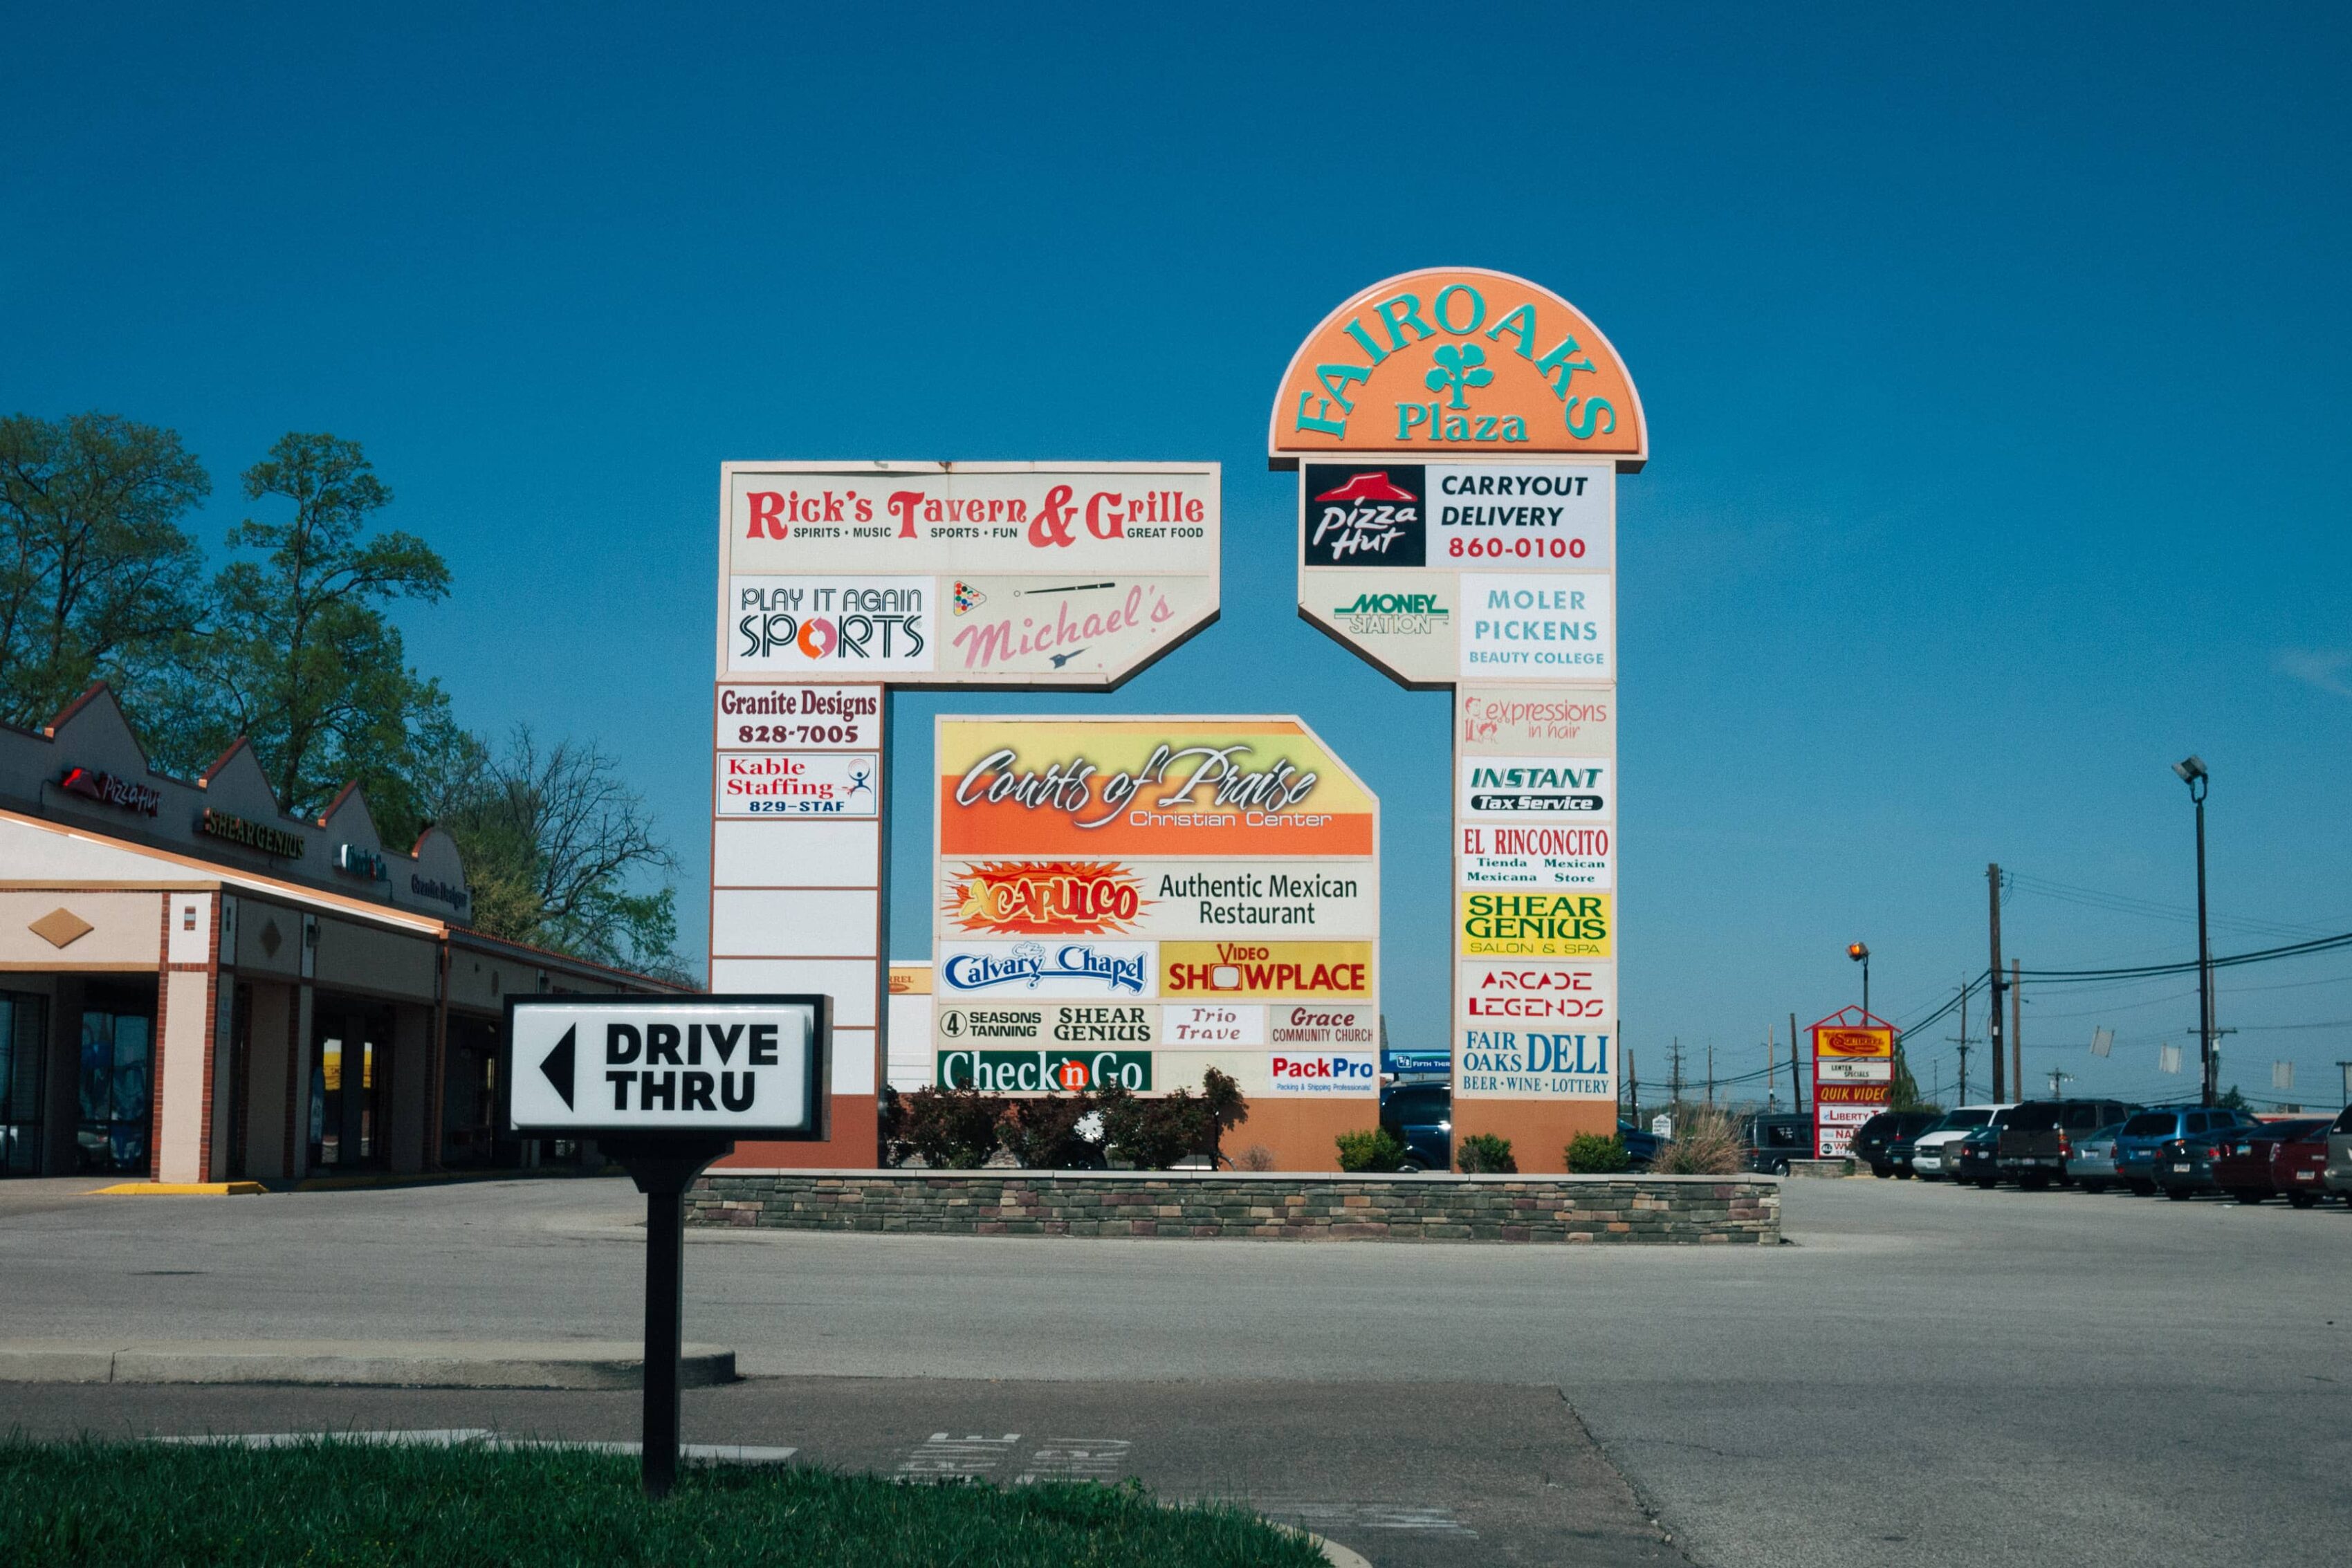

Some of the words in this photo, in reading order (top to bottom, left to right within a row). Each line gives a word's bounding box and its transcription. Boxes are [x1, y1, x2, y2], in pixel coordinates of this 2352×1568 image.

[1395, 402, 1529, 442] Plaza
[1442, 476, 1588, 497] CARRYOUT
[746, 490, 872, 540] Rick's
[888, 490, 1027, 539] Tavern
[1028, 484, 1078, 548] &
[1086, 490, 1204, 539] Grille
[1441, 506, 1564, 526] DELIVERY
[793, 527, 840, 538] SPIRITS
[853, 526, 892, 538] MUSIC
[930, 527, 980, 538] SPORTS
[993, 527, 1018, 538] FUN
[1127, 527, 1168, 538] GREAT
[1170, 527, 1204, 538] FOOD
[1332, 526, 1405, 560] Hut
[1449, 537, 1586, 558] 860-0100
[742, 588, 803, 612] PLAY
[814, 588, 836, 611] IT
[843, 588, 921, 612] AGAIN
[1334, 594, 1449, 614] MONEY
[1487, 590, 1585, 610] MOLER
[953, 585, 1175, 669] Michael's
[1349, 614, 1433, 634] STATION
[1475, 621, 1597, 640] PICKENS
[1469, 652, 1528, 665] BEAUTY
[1534, 652, 1604, 665] COLLEGE
[722, 690, 796, 715] Granite
[801, 690, 876, 722] Designs
[1485, 700, 1607, 725] expressions
[739, 726, 858, 743] 828-7005
[1528, 722, 1541, 739] in
[1547, 722, 1580, 739] hair
[729, 759, 805, 775] Kable
[956, 750, 1096, 811] Courts
[1074, 745, 1170, 828] of
[1158, 746, 1318, 811] Praise
[1471, 768, 1604, 788] INSTANT
[726, 778, 834, 800] Staffing
[750, 801, 845, 812] 829-STAF
[1478, 796, 1515, 809] Tax
[1517, 796, 1593, 810] Service
[1130, 810, 1236, 827] Christian
[1247, 811, 1332, 827] Center
[209, 808, 255, 845] SHEAR
[256, 824, 305, 859] GENIUS
[1464, 829, 1485, 854] EL
[1495, 829, 1608, 856] RINCONCITO
[1476, 858, 1527, 867] Tienda
[1544, 858, 1606, 868] Mexican
[1159, 873, 1262, 899] Authentic
[1269, 874, 1357, 898] Mexican
[1467, 872, 1537, 882] Mexicana
[1554, 873, 1595, 883] Store
[1200, 901, 1315, 925] Restaurant
[1469, 895, 1603, 918] SHEAR
[1465, 917, 1606, 940] GENIUS
[1217, 943, 1269, 963] VIDEO
[1471, 943, 1534, 953] SALON
[1542, 943, 1556, 953] &
[1564, 944, 1600, 954] SPA
[945, 954, 1045, 989] Calvary
[1058, 946, 1146, 993] Chapel
[1481, 971, 1592, 990] ARCADE
[1059, 1007, 1145, 1024] SHEAR
[1192, 1008, 1236, 1023] Trio
[1290, 1007, 1354, 1026] Grace
[1469, 997, 1604, 1017] LEGENDS
[970, 1012, 1042, 1024] SEASONS
[971, 1025, 1038, 1037] TANNING
[1054, 1024, 1151, 1042] GENIUS
[1273, 1029, 1330, 1042] COMMUNITY
[1335, 1029, 1372, 1042] CHURCH
[1466, 1031, 1517, 1050] FAIR
[606, 1023, 778, 1067] DRIVE
[1526, 1033, 1609, 1074] DELI
[1273, 1058, 1373, 1078] PackPro
[1463, 1052, 1521, 1071] OAKS
[605, 1071, 755, 1112] THRU
[1277, 1083, 1298, 1092] Packing
[1307, 1083, 1331, 1092] Shipping
[1463, 1076, 1498, 1090] BEER
[1506, 1077, 1541, 1091] WINE
[1552, 1078, 1609, 1094] LOTTERY
[1820, 1087, 1849, 1100] QUIK
[1830, 1110, 1868, 1121] LIBERTY
